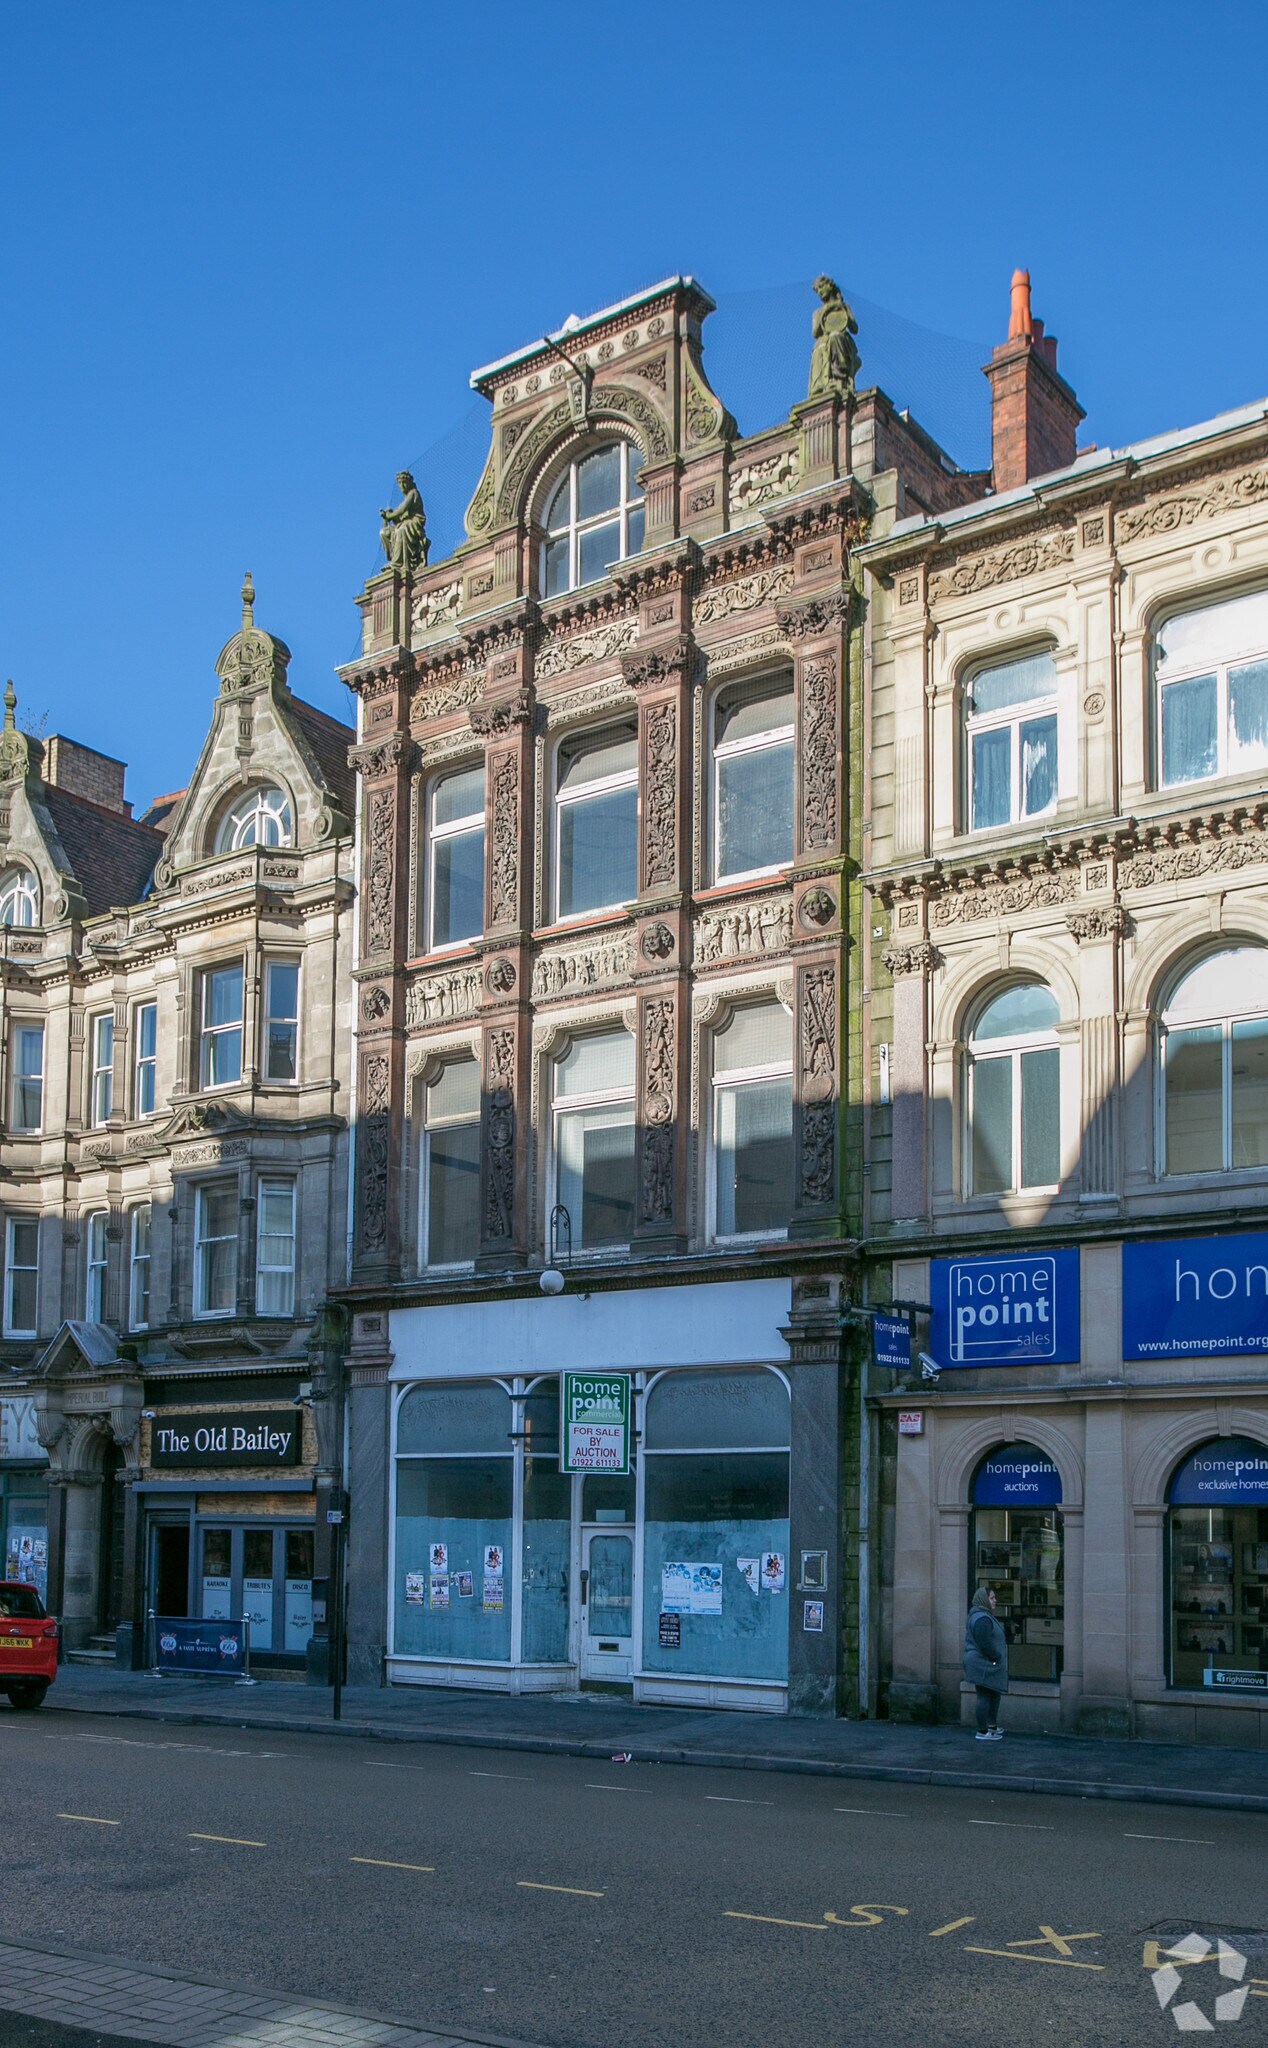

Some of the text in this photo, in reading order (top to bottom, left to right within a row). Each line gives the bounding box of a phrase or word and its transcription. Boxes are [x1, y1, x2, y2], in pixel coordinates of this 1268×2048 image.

[957, 1268, 1049, 1297] home
[874, 1320, 910, 1338] homepoint
[957, 1295, 1050, 1361] point
[1017, 1331, 1051, 1346] sales
[572, 1377, 621, 1395] home
[572, 1394, 621, 1422] point
[577, 1410, 621, 1419] commercial
[573, 1427, 620, 1437] FOR SALE
[157, 1425, 292, 1456] The Old Bailey
[589, 1437, 602, 1446] BY
[575, 1447, 617, 1458] AUCTION
[571, 1458, 621, 1467] 01922 611133
[986, 1461, 1058, 1479] homepoint
[1004, 1482, 1039, 1492] auctions
[1198, 1479, 1238, 1490] exclusive
[1225, 1675, 1264, 1684] rightmove
